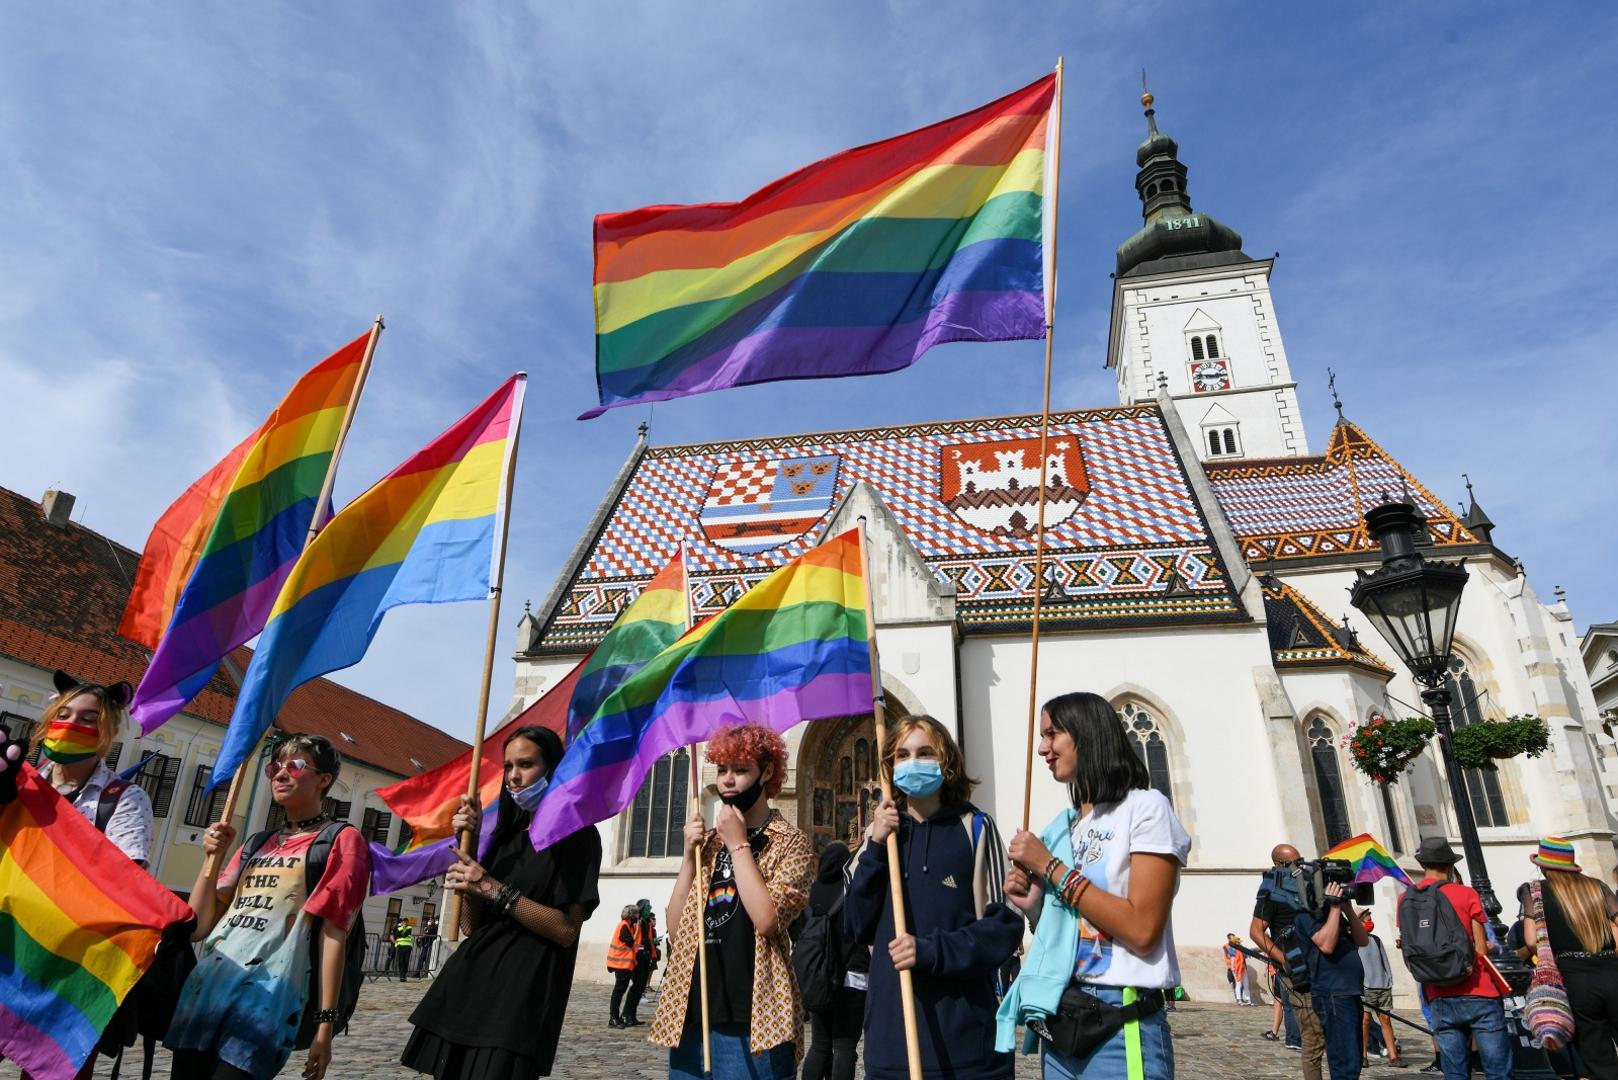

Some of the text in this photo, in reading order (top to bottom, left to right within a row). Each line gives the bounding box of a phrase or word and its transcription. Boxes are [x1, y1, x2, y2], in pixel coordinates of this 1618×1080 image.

[247, 857, 300, 869] WHAT
[245, 875, 279, 888] THE
[234, 895, 274, 910] HELL
